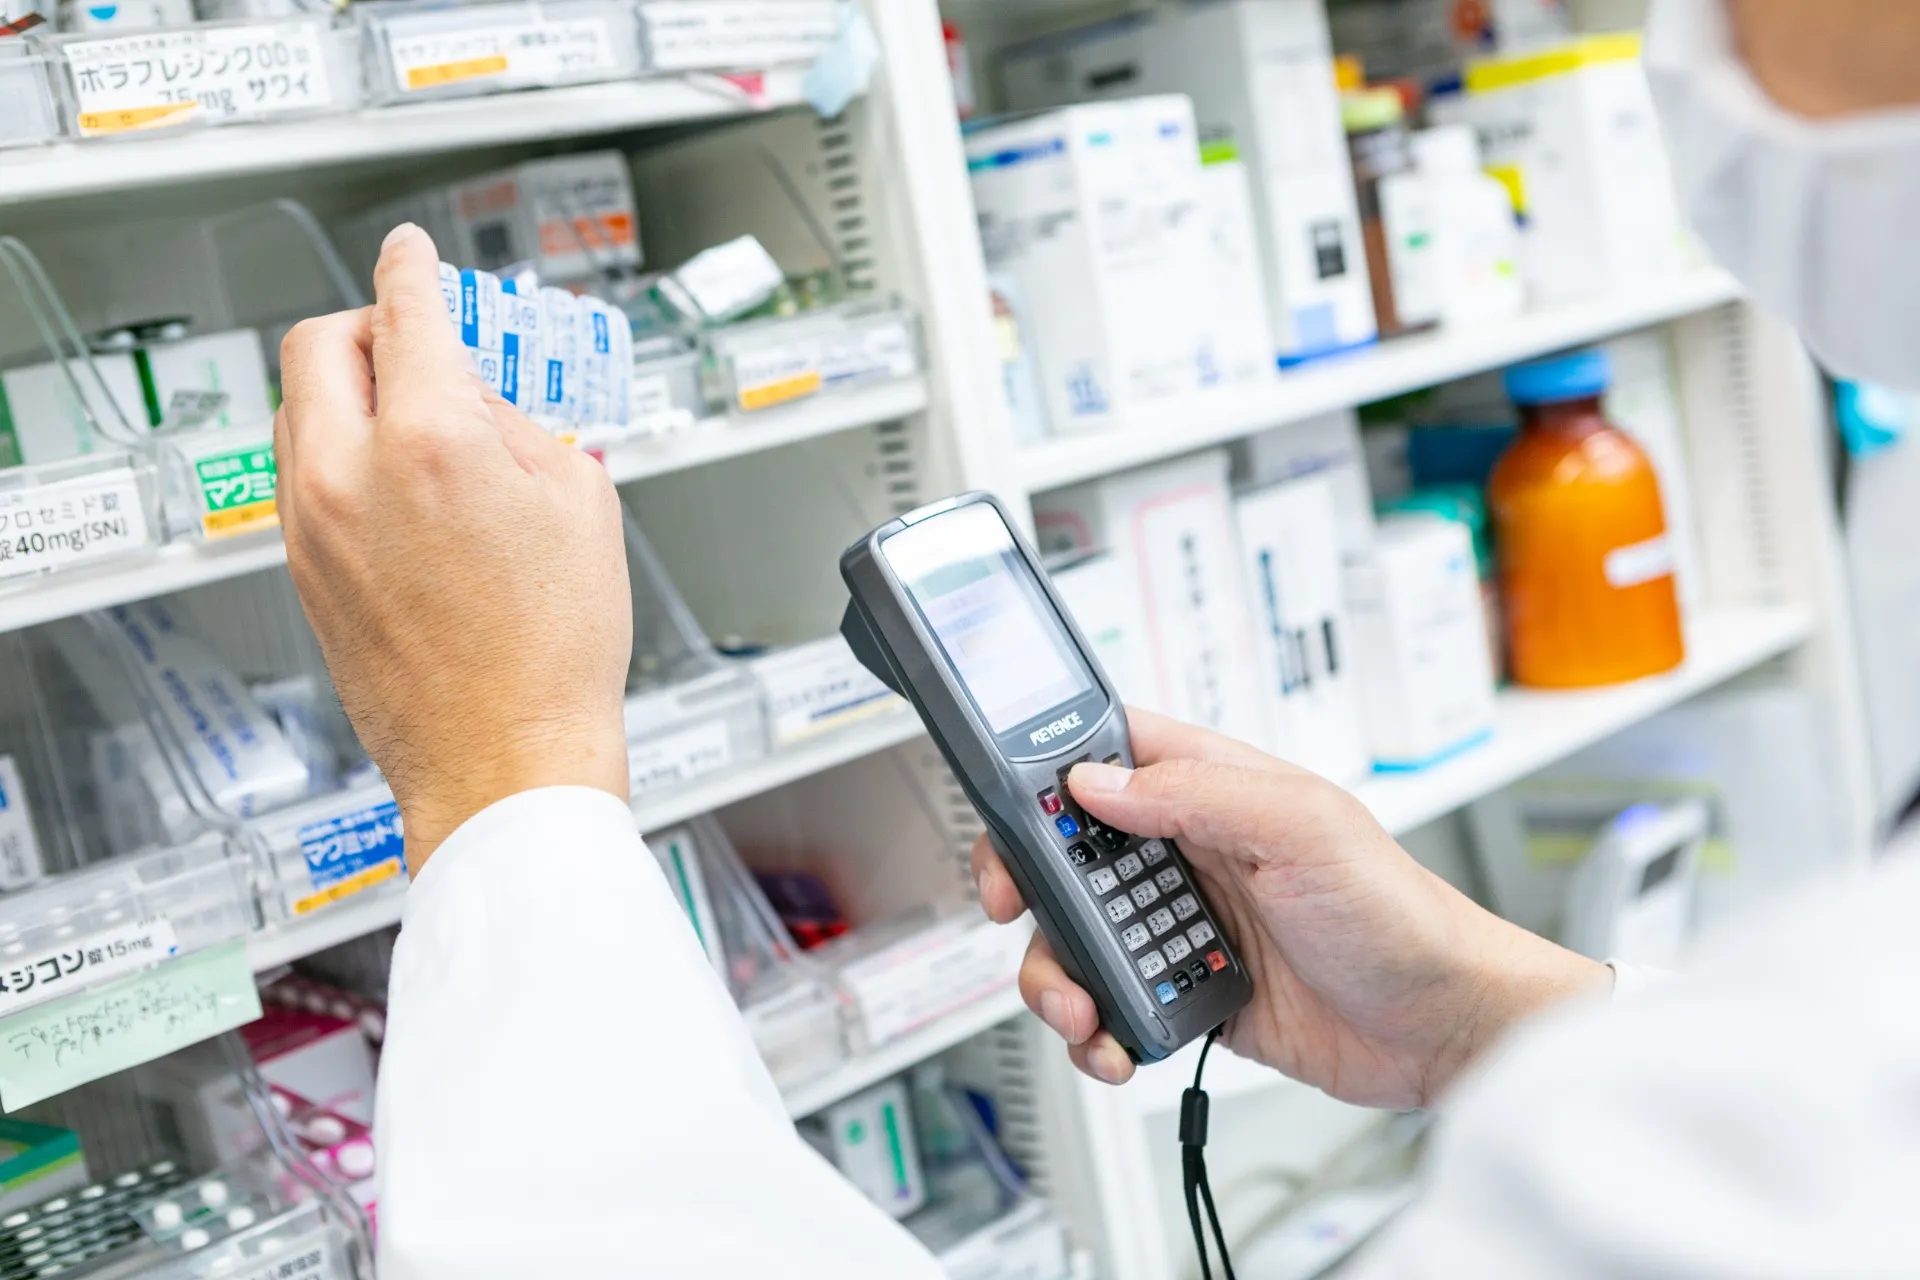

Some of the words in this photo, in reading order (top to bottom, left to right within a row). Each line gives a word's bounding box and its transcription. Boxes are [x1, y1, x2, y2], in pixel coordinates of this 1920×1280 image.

[248, 73, 310, 102] サワイ
[1029, 711, 1083, 747] KEYENCE
